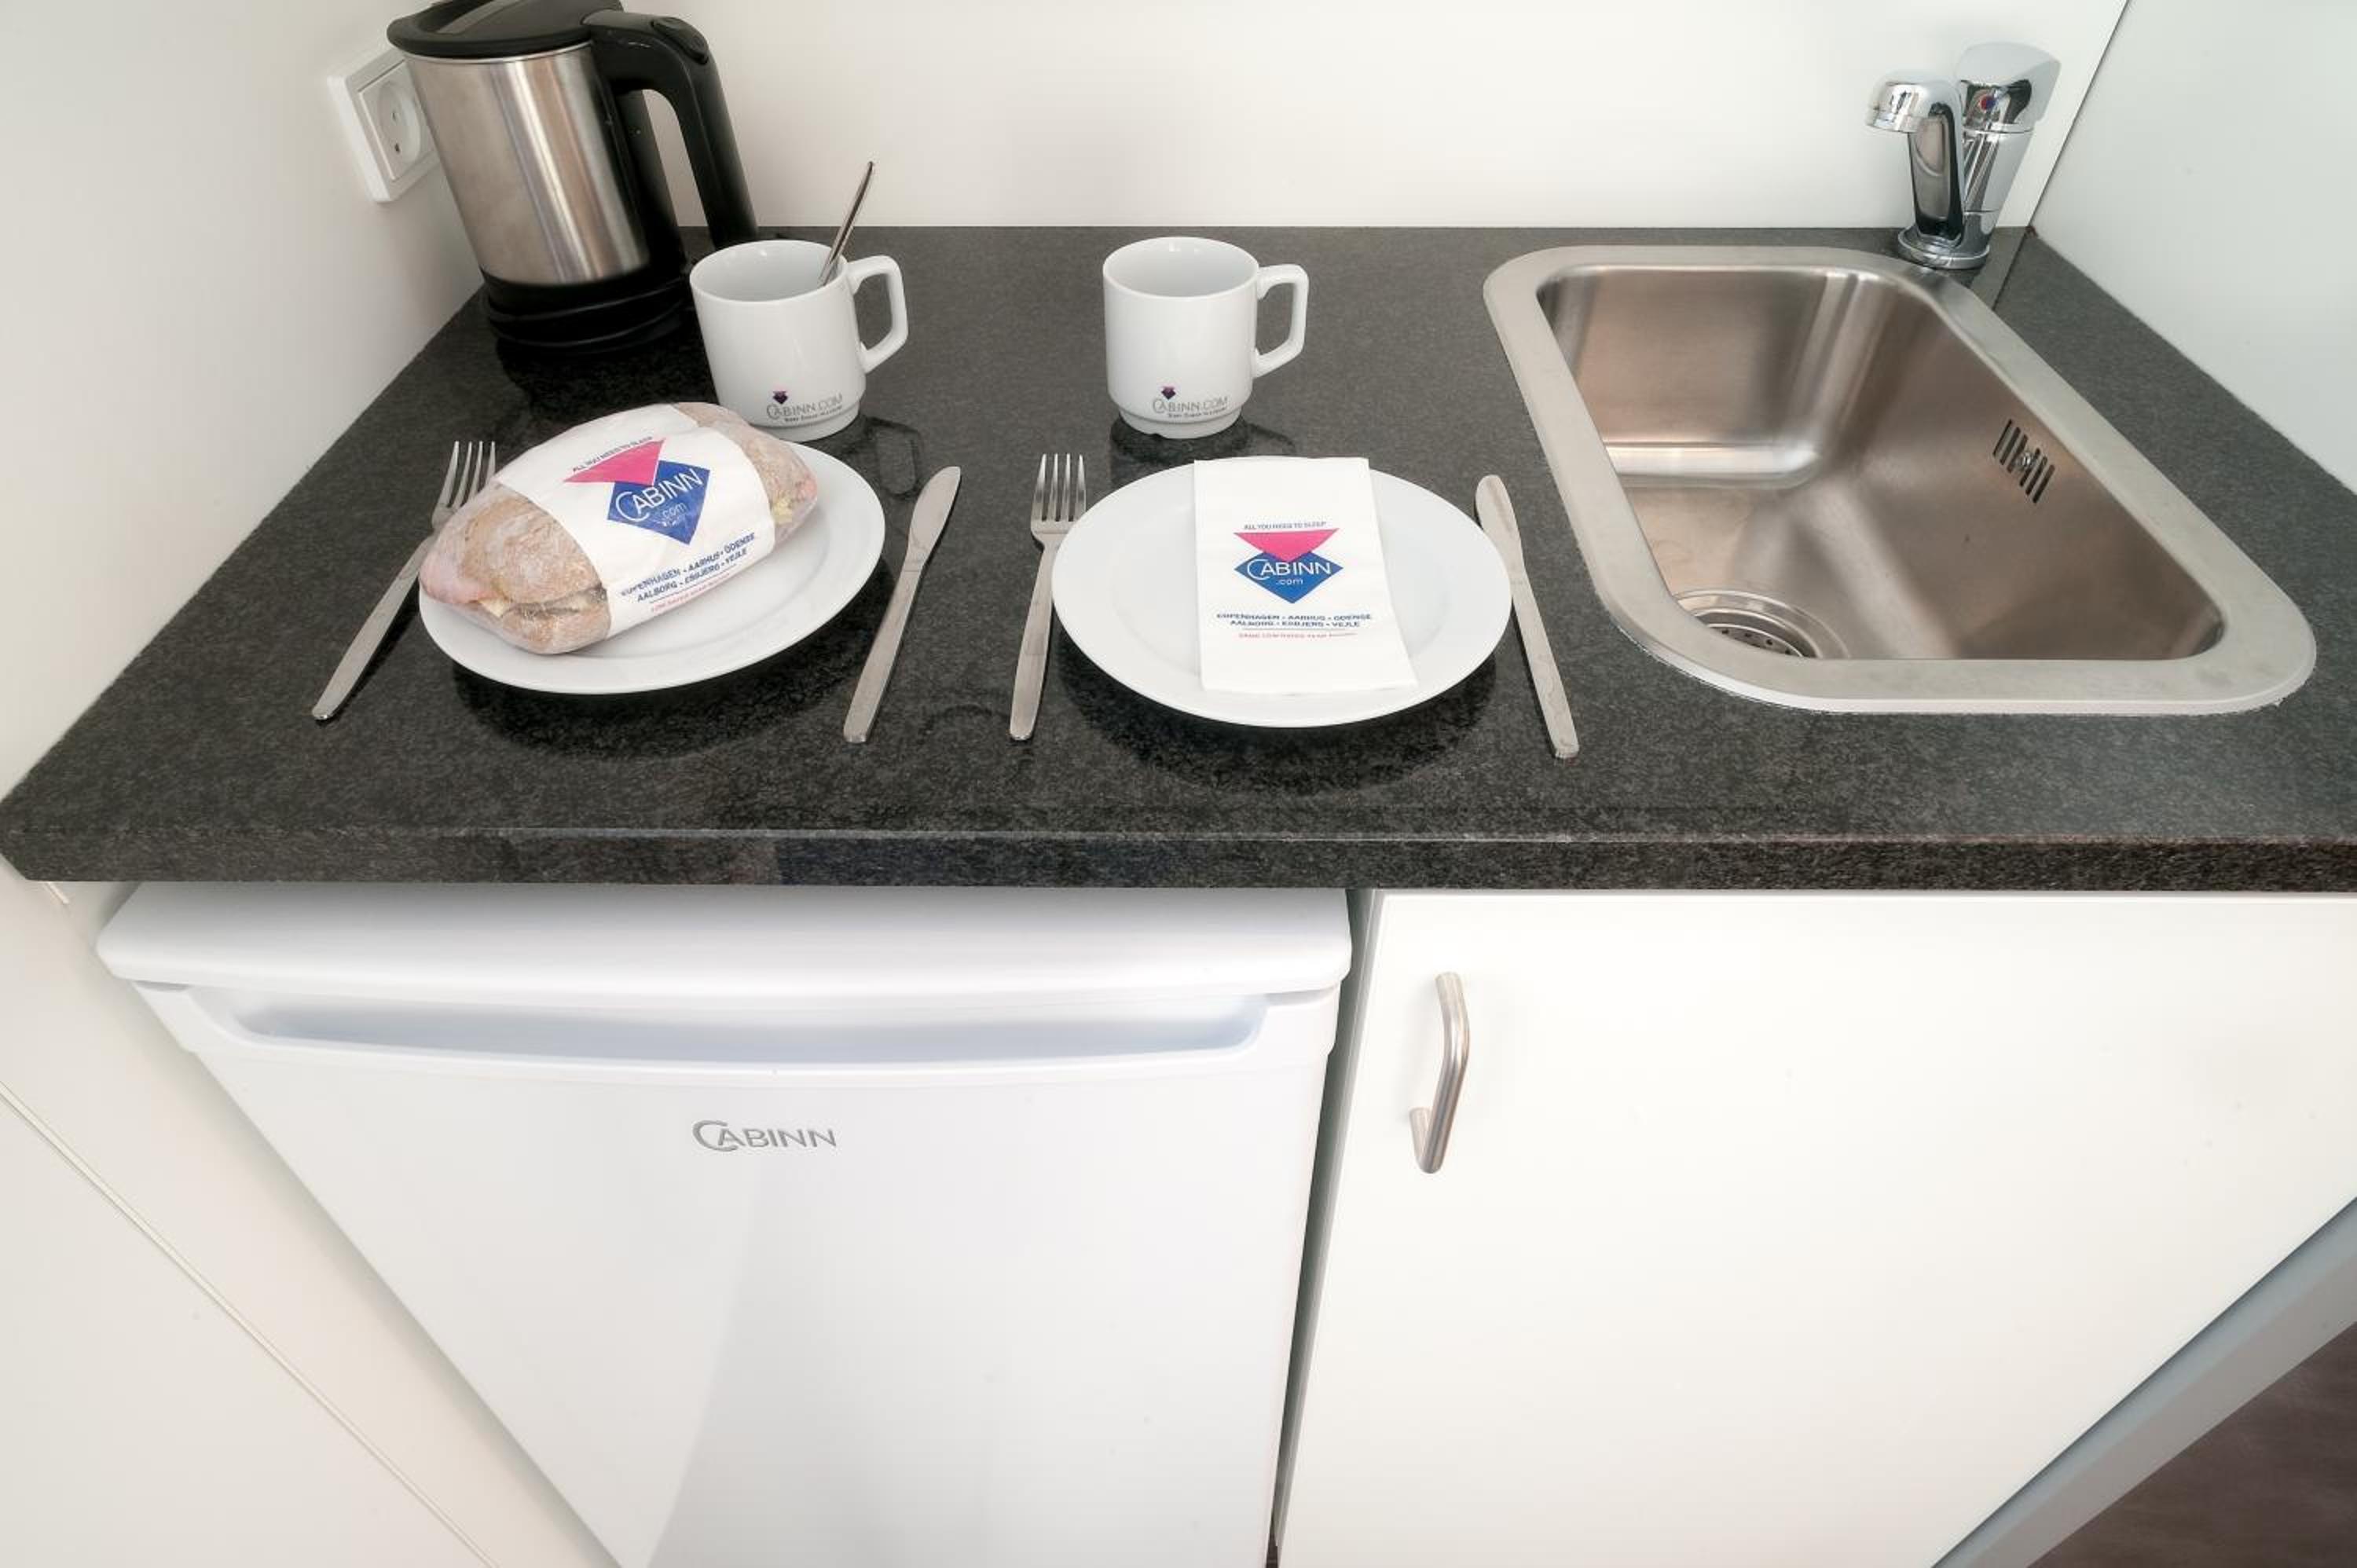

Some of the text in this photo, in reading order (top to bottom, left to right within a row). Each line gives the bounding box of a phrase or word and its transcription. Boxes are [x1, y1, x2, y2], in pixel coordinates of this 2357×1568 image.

[616, 467, 703, 522] CABINN
[687, 551, 720, 572] AARHUS
[1247, 559, 1332, 581] CABINN
[692, 1119, 837, 1152] CABINN
